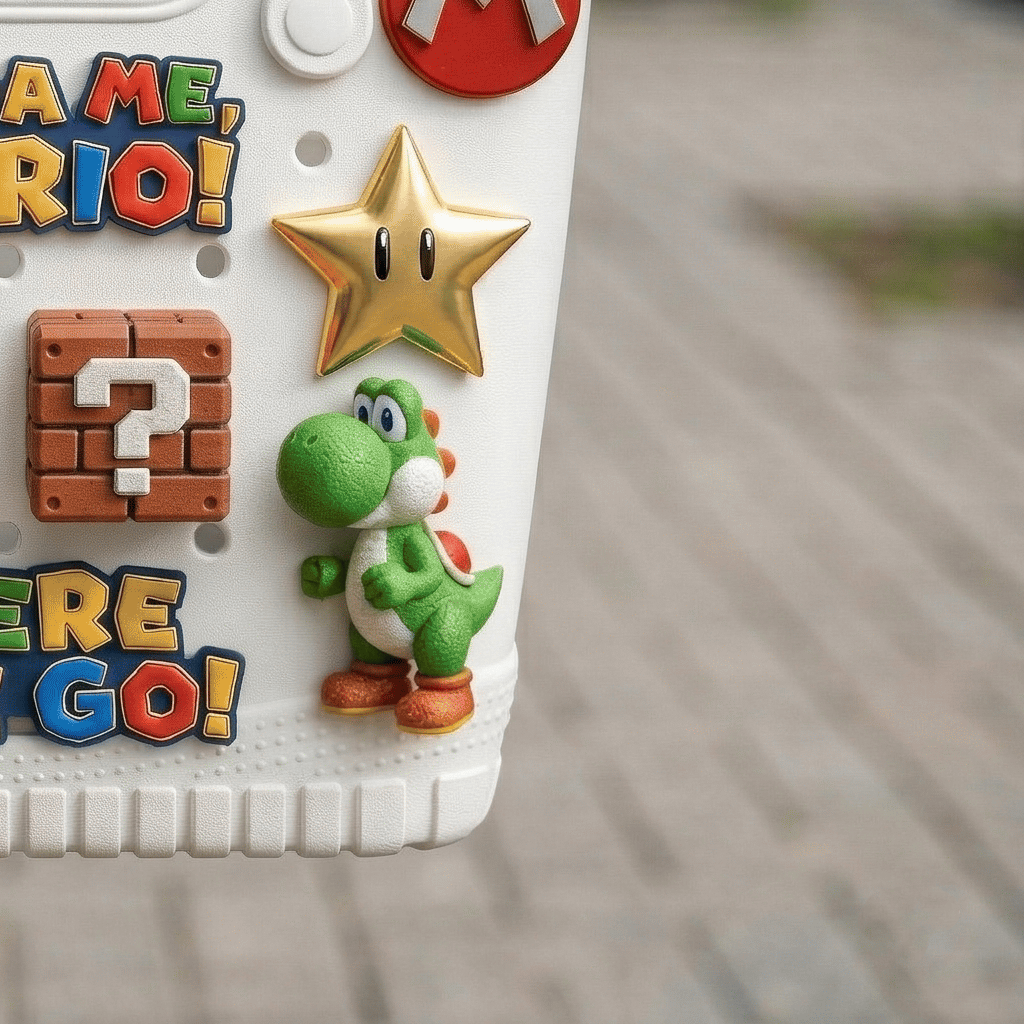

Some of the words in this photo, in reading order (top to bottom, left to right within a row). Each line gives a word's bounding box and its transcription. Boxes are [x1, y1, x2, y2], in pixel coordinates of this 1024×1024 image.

[84, 58, 241, 134] ME,
[74, 357, 191, 495] ?
[33, 655, 239, 743] GO!
